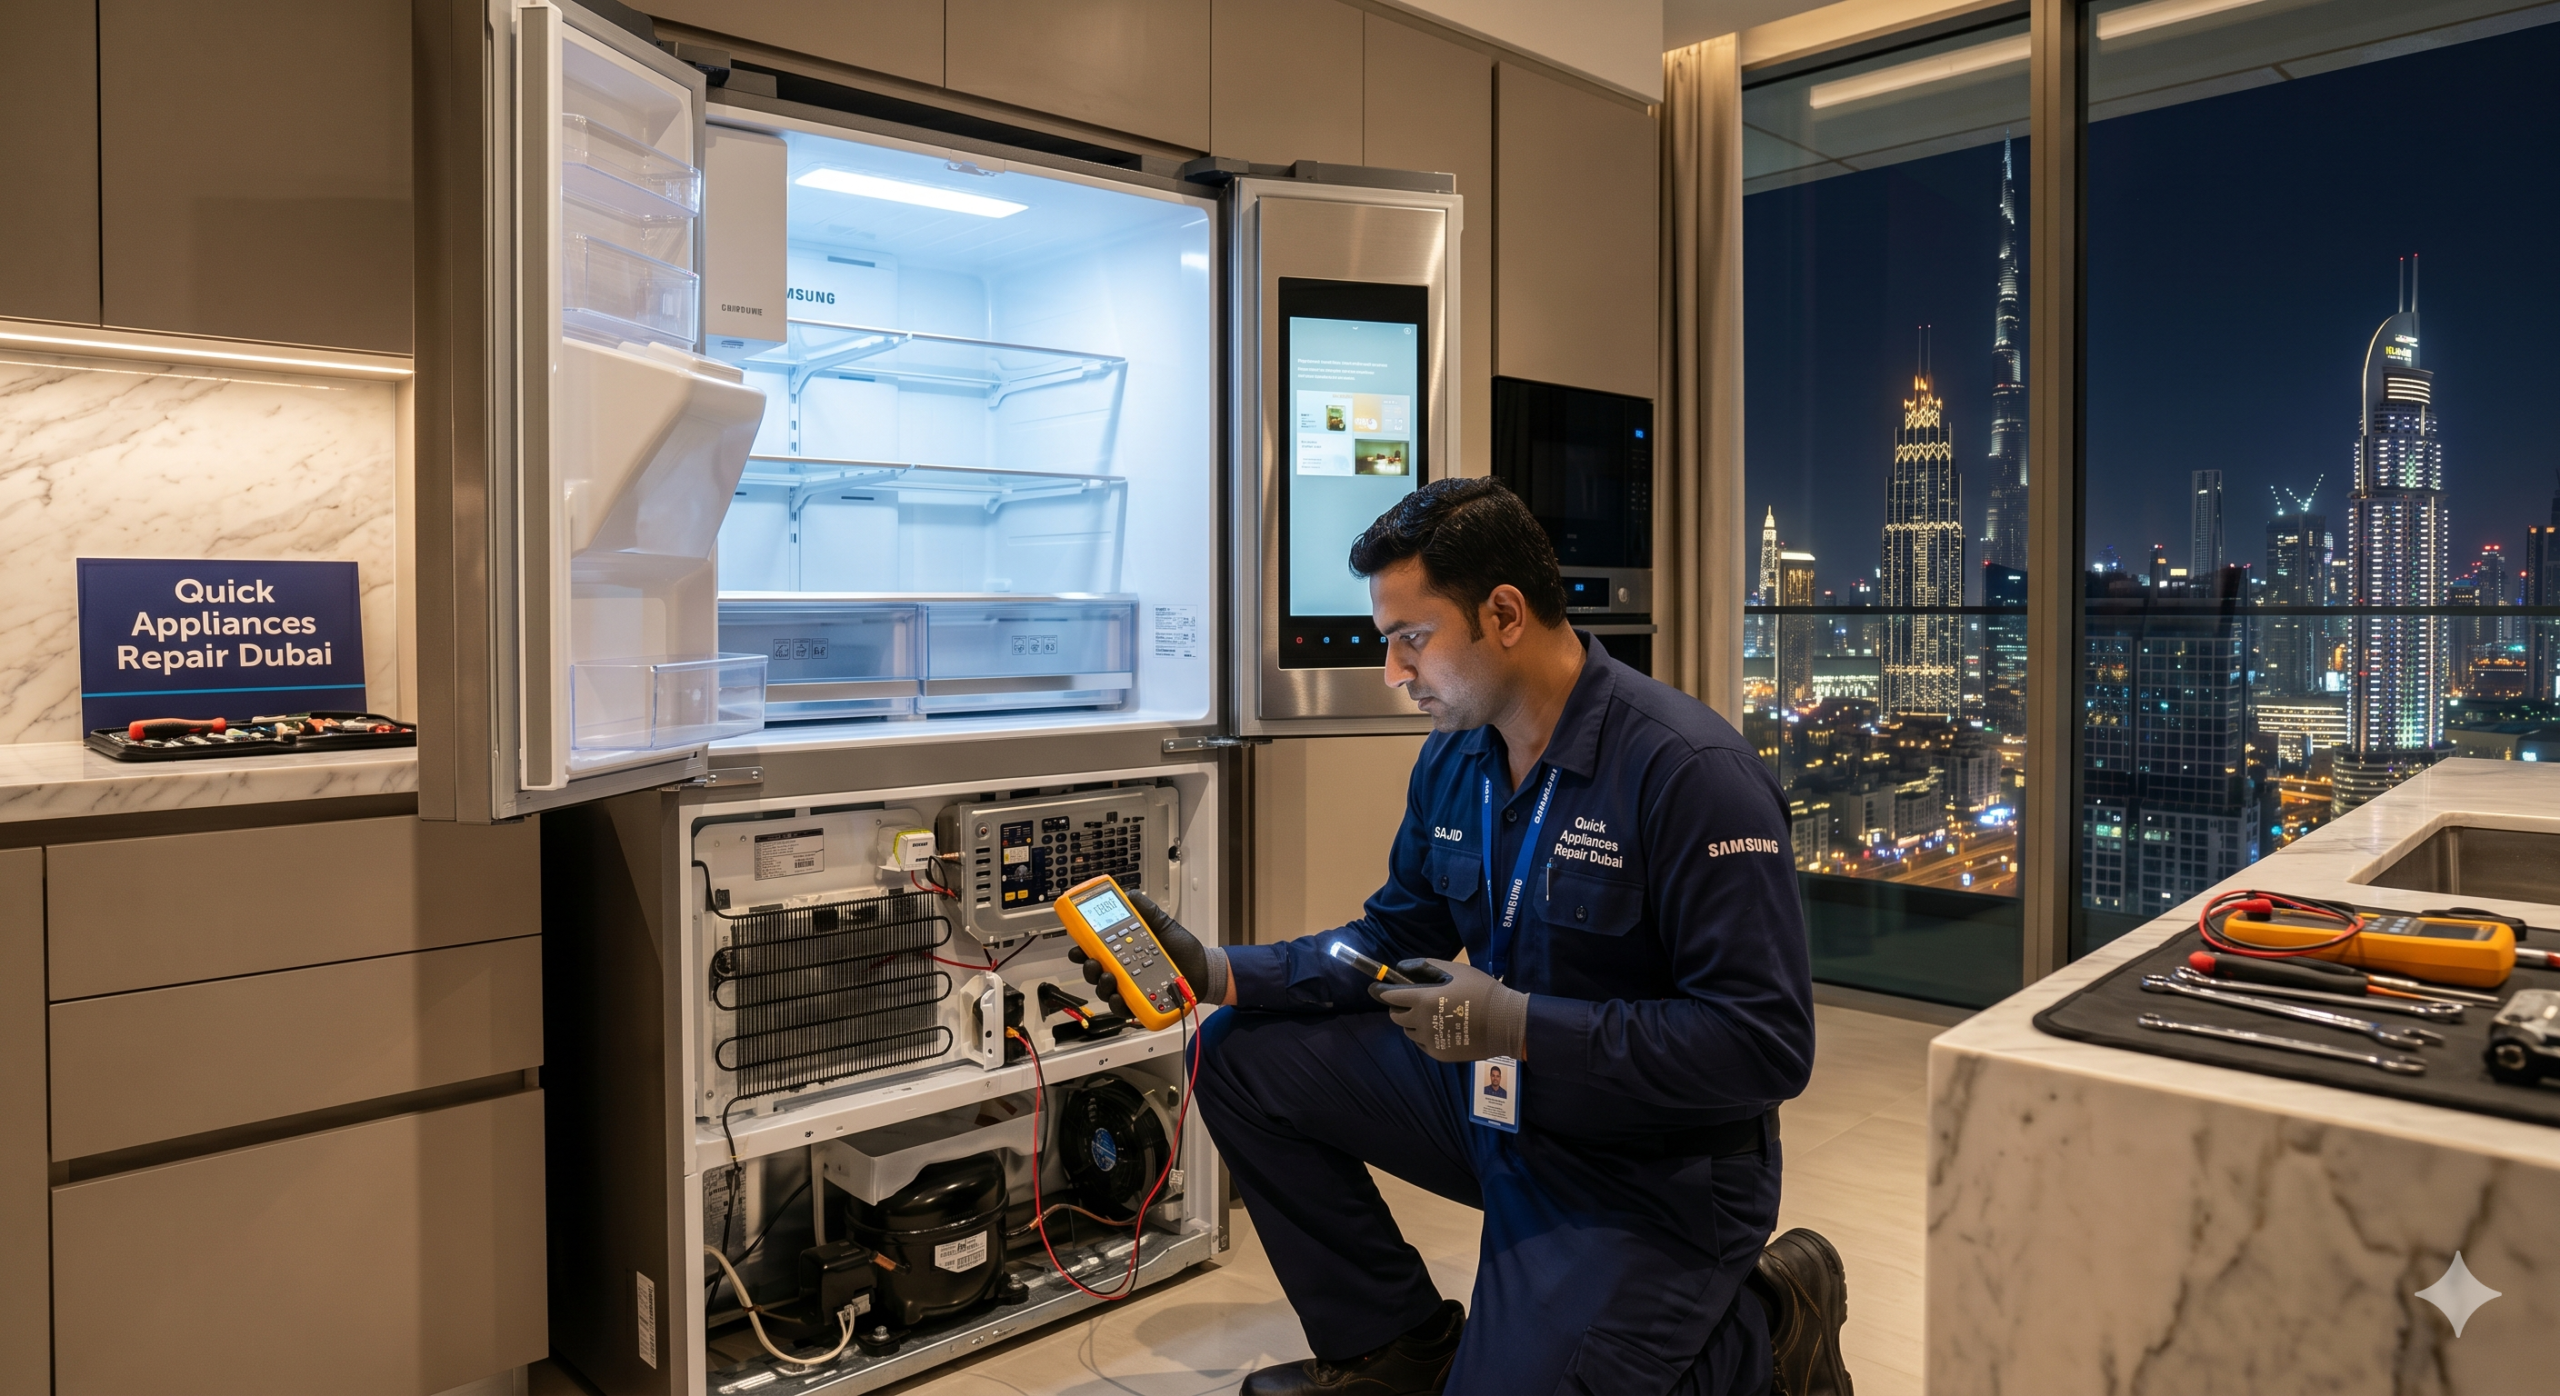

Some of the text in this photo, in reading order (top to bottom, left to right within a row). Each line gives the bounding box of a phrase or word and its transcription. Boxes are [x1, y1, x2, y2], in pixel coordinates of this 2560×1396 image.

[174, 578, 275, 604] Quick
[131, 610, 317, 642] Appliances
[117, 642, 333, 676] Repair Dubai
[1434, 827, 1463, 841] SAJID
[1574, 816, 1607, 834] Quick
[1559, 830, 1619, 852] Appliances
[1708, 838, 1778, 857] SAMSUNG
[1553, 843, 1624, 869] Repair Dubai
